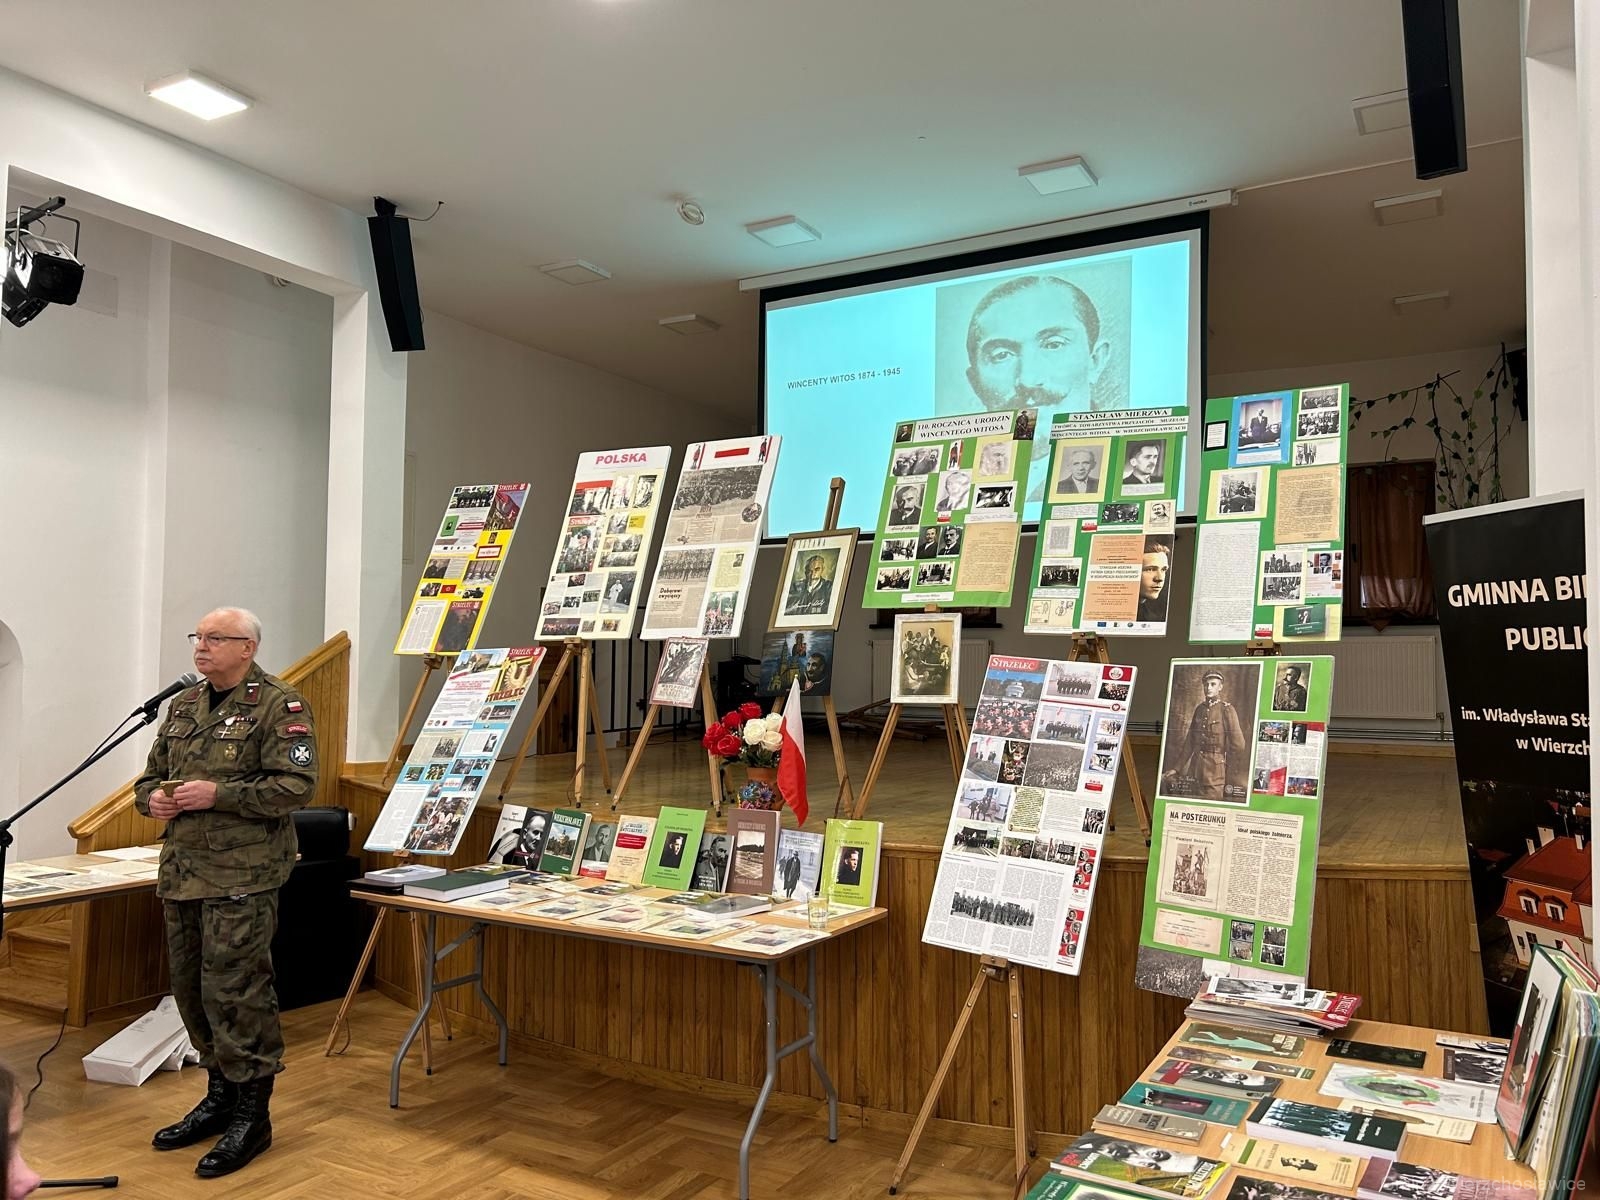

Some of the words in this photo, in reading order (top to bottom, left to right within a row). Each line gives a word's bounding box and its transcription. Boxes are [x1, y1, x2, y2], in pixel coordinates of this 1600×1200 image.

[787, 377, 829, 390] WINCENTY
[829, 373, 856, 384] WITOS
[858, 370, 876, 380] 1874
[883, 367, 901, 377] 1945
[1072, 412, 1122, 421] STANISŁAW
[1124, 409, 1169, 417] MIERZWA
[931, 419, 972, 430] ROCZNICA
[974, 415, 1011, 425] URODZIN
[920, 428, 972, 438] WINCENTEGO
[973, 424, 1005, 434] WITOSA
[595, 452, 648, 465] POLSKA
[1447, 578, 1550, 607] GMINNA
[991, 657, 1036, 671] STRZELEC
[1461, 706, 1480, 721] im.
[1482, 707, 1568, 728] Władysława
[1516, 738, 1528, 750] w
[1169, 811, 1179, 819] NA
[1181, 811, 1226, 824] POSTERUNKU
